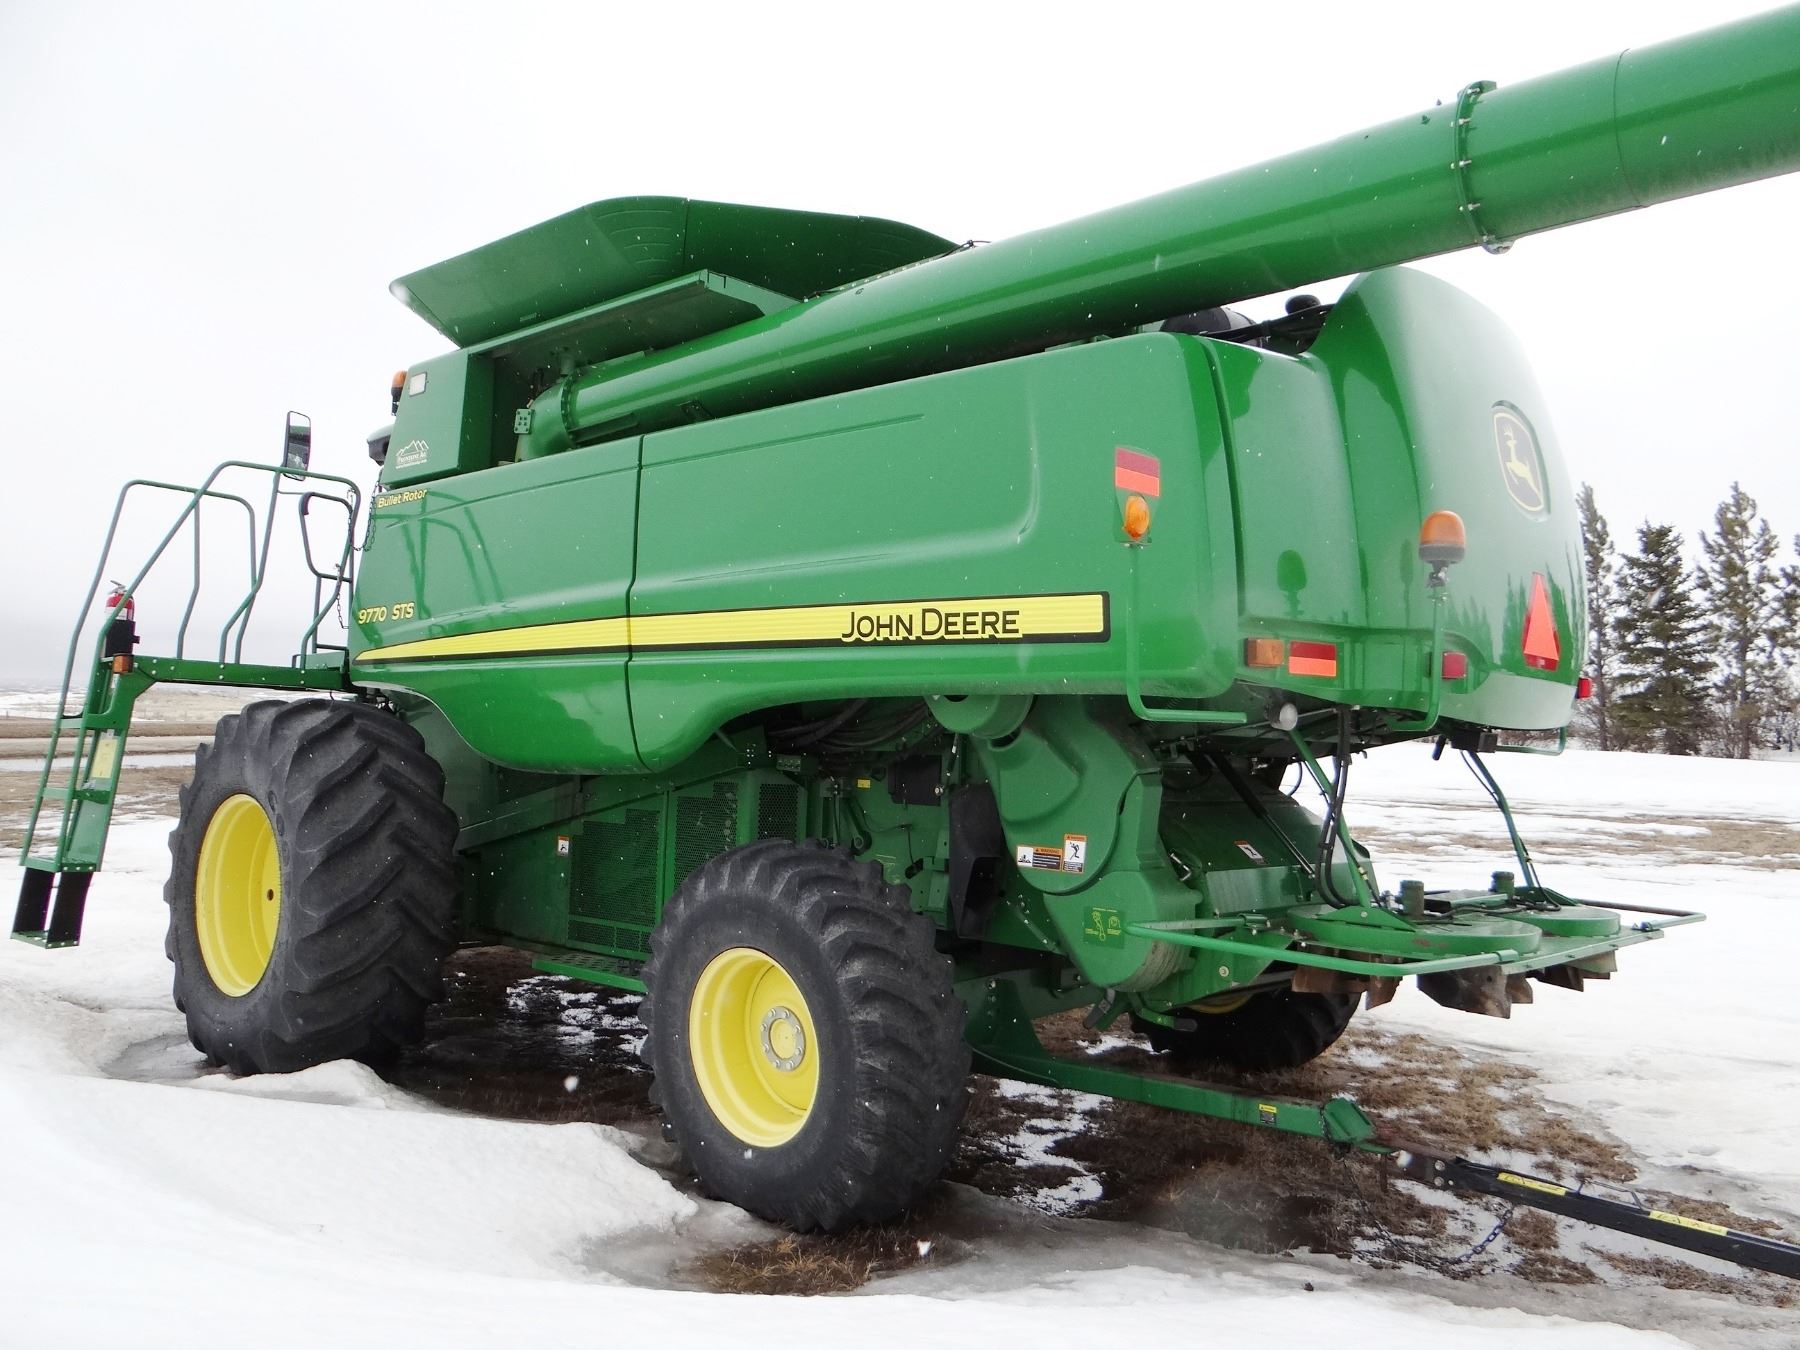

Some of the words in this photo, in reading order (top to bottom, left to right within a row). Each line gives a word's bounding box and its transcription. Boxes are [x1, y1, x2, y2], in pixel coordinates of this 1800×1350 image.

[378, 494, 402, 508] Bullet
[403, 489, 428, 502] Rotor
[358, 606, 387, 625] 9770
[391, 602, 415, 620] STS
[841, 611, 914, 640] JOHN
[921, 608, 1021, 639] DEERE
